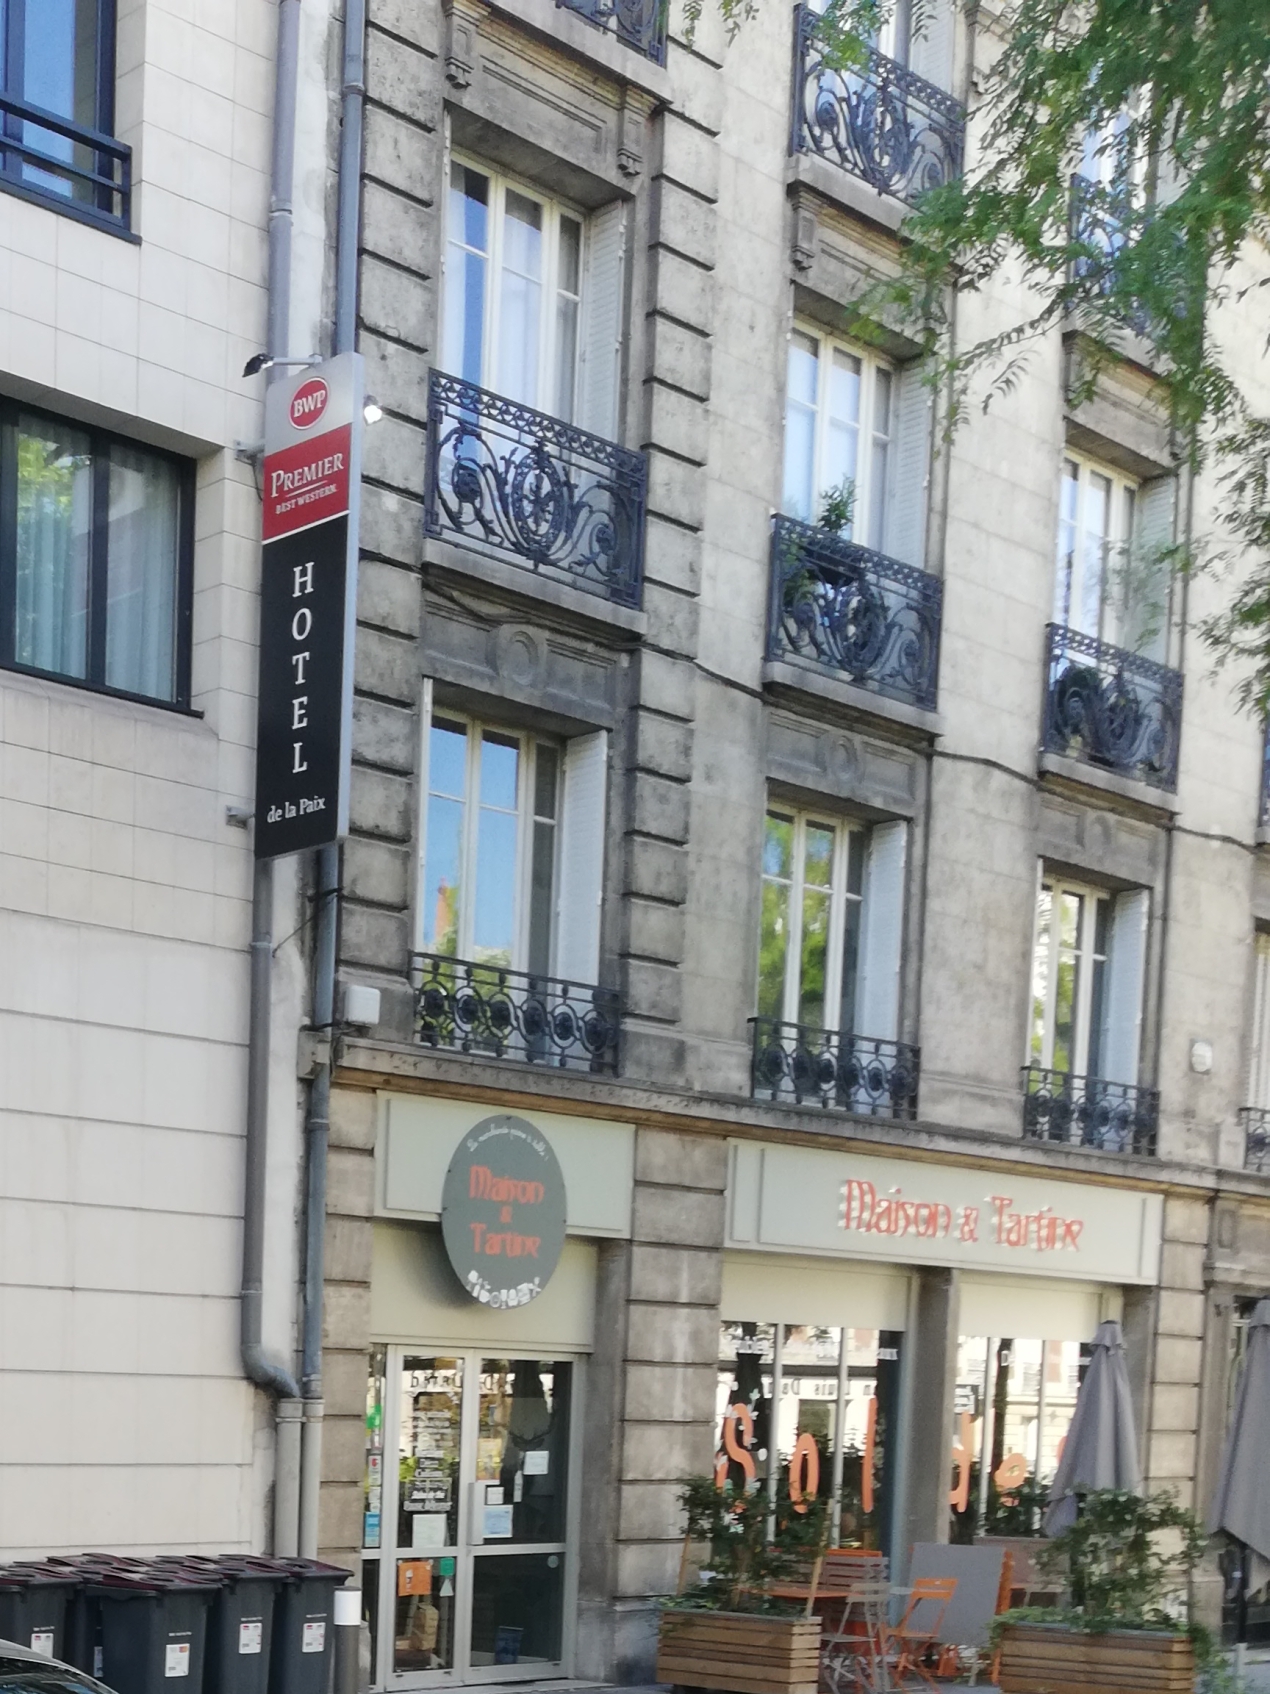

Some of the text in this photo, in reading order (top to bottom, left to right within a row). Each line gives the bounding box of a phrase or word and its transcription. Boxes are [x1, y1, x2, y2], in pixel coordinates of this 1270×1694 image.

[293, 389, 326, 418] BWP
[270, 453, 344, 498] PREMIER
[275, 483, 337, 515] BEST WESTERN
[292, 562, 314, 773] HOTEL
[267, 795, 326, 823] de la Paix
[468, 1165, 545, 1206] Maison
[843, 1179, 1084, 1252] Maison & Tartine
[714, 1401, 1068, 1515] Solde
